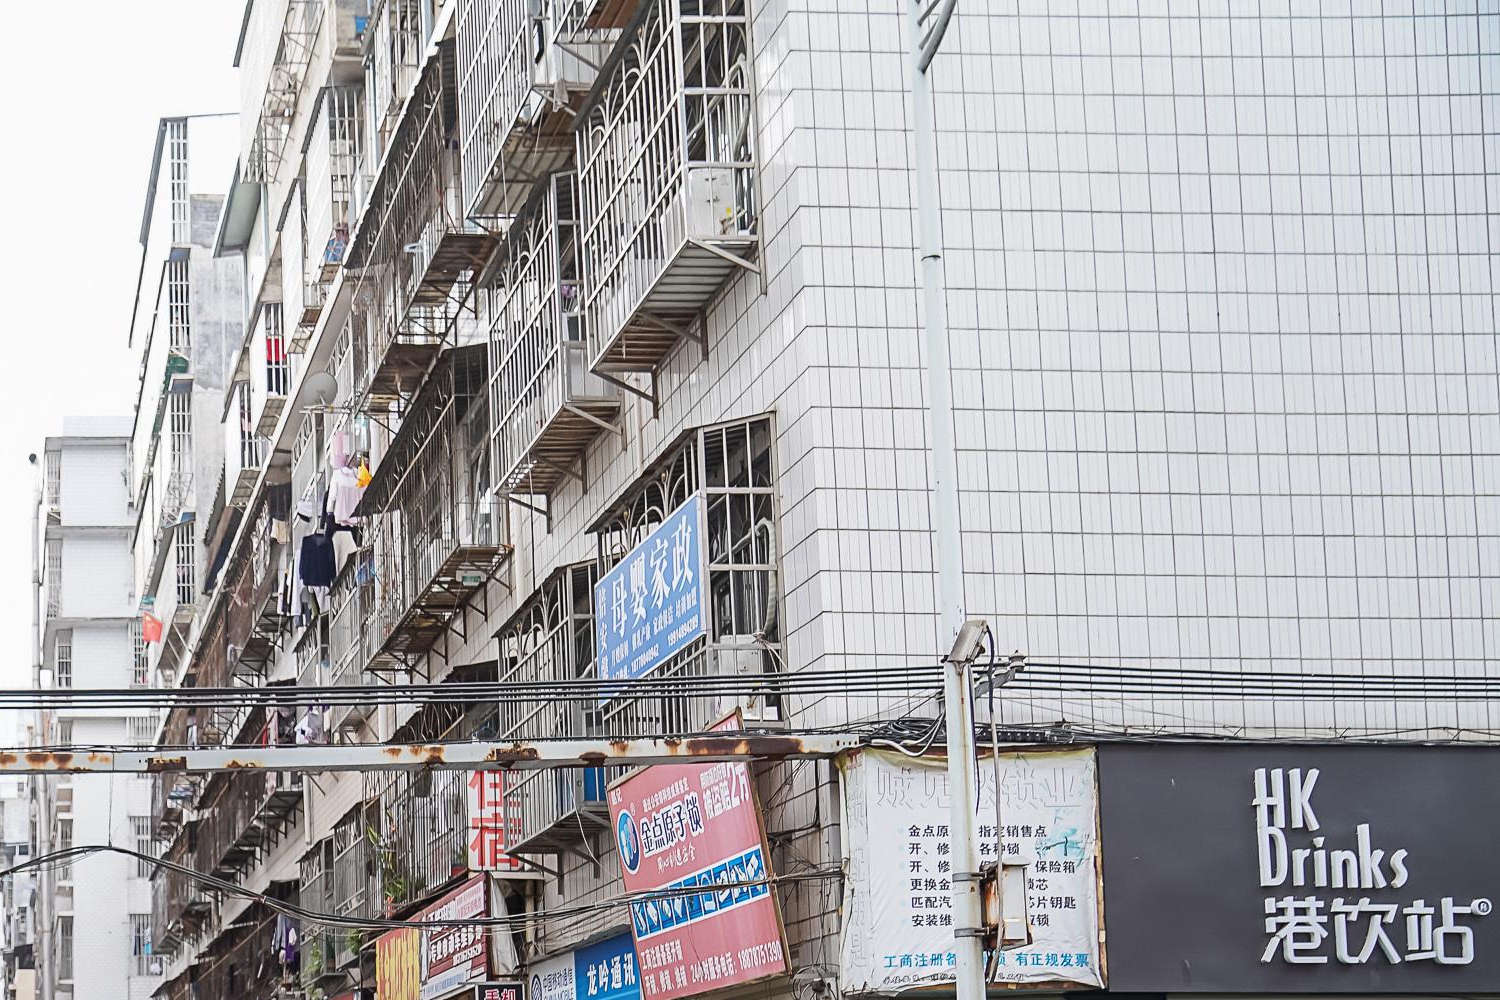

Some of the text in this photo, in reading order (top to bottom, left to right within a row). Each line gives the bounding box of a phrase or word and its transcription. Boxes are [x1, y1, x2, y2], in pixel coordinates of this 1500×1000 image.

[610, 514, 694, 638] 母婴家政
[468, 769, 522, 868] 住宿
[640, 793, 704, 855] 金点原子锁
[1252, 767, 1320, 832] HK
[1256, 823, 1409, 889] Drinks
[1015, 952, 1091, 968] 有正规发票
[1260, 895, 1475, 965] 港饮站
[586, 951, 636, 997] 龙吟通讯
